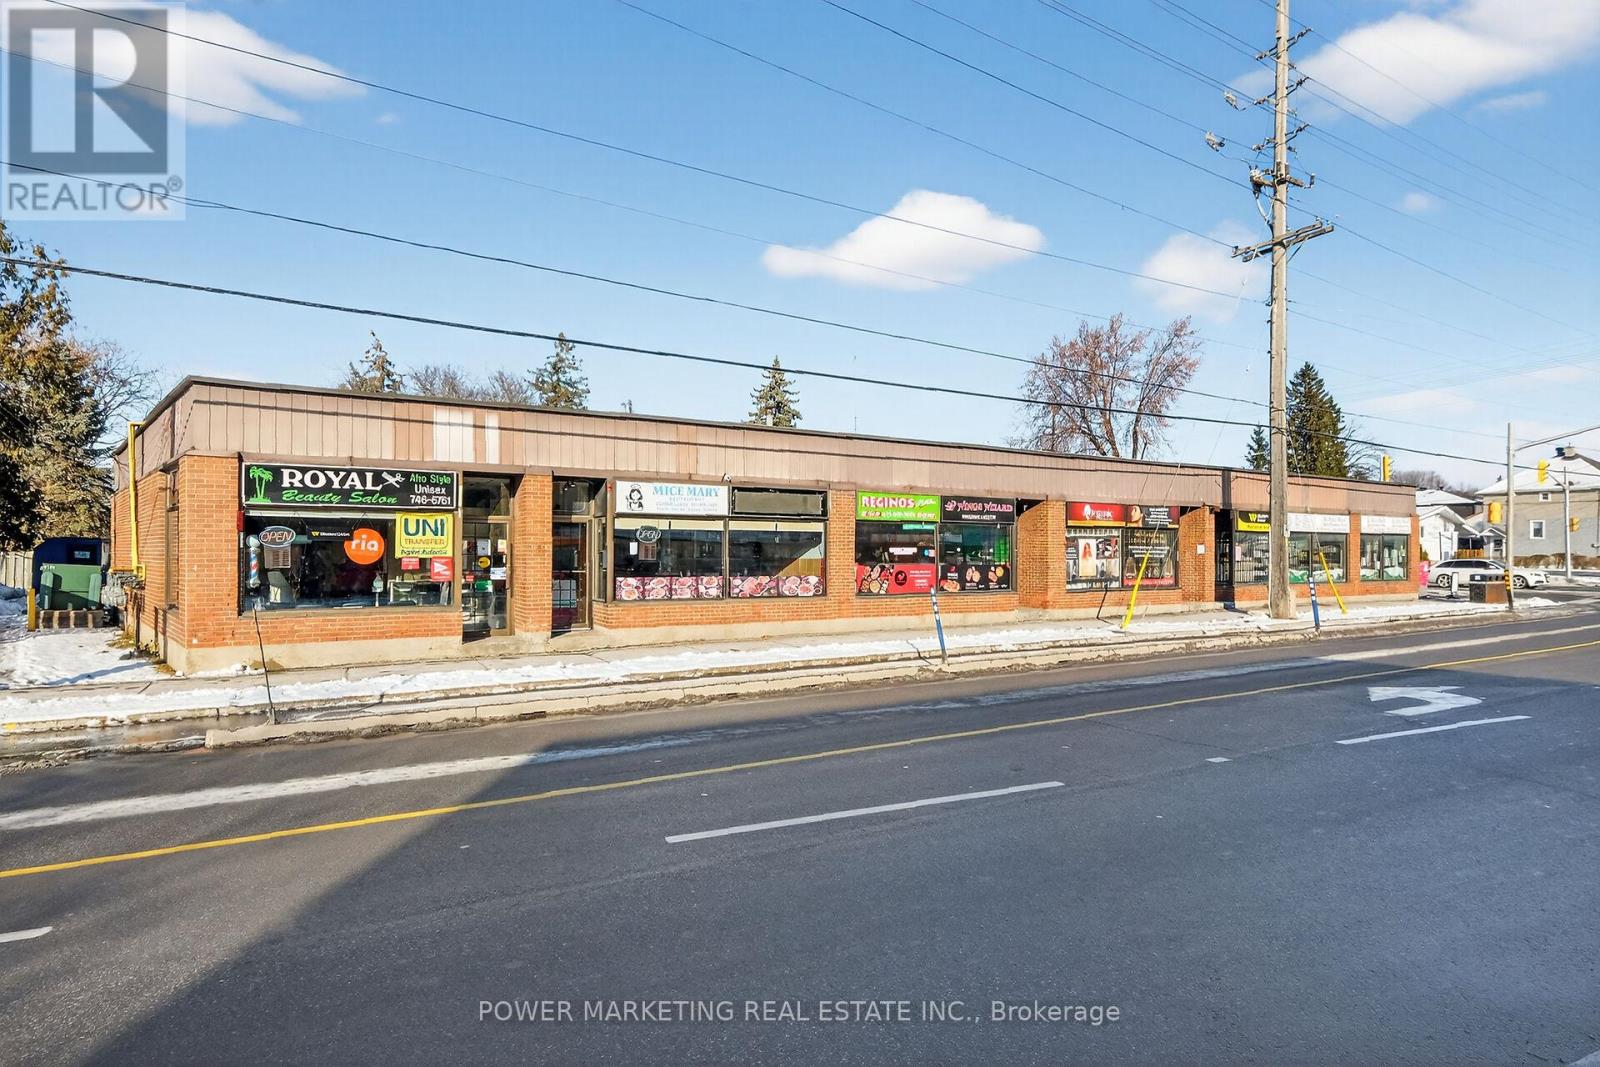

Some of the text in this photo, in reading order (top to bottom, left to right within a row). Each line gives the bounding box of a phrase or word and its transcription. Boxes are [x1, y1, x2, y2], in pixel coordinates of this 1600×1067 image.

[280, 468, 382, 490] ROYAL
[410, 473, 451, 485] Afro Style
[414, 484, 446, 494] Unisex
[687, 486, 720, 497] MARY
[282, 489, 398, 504] Beauty Salon
[404, 518, 445, 536] UNI
[261, 531, 294, 542] OPEN
[351, 534, 379, 551] ria
